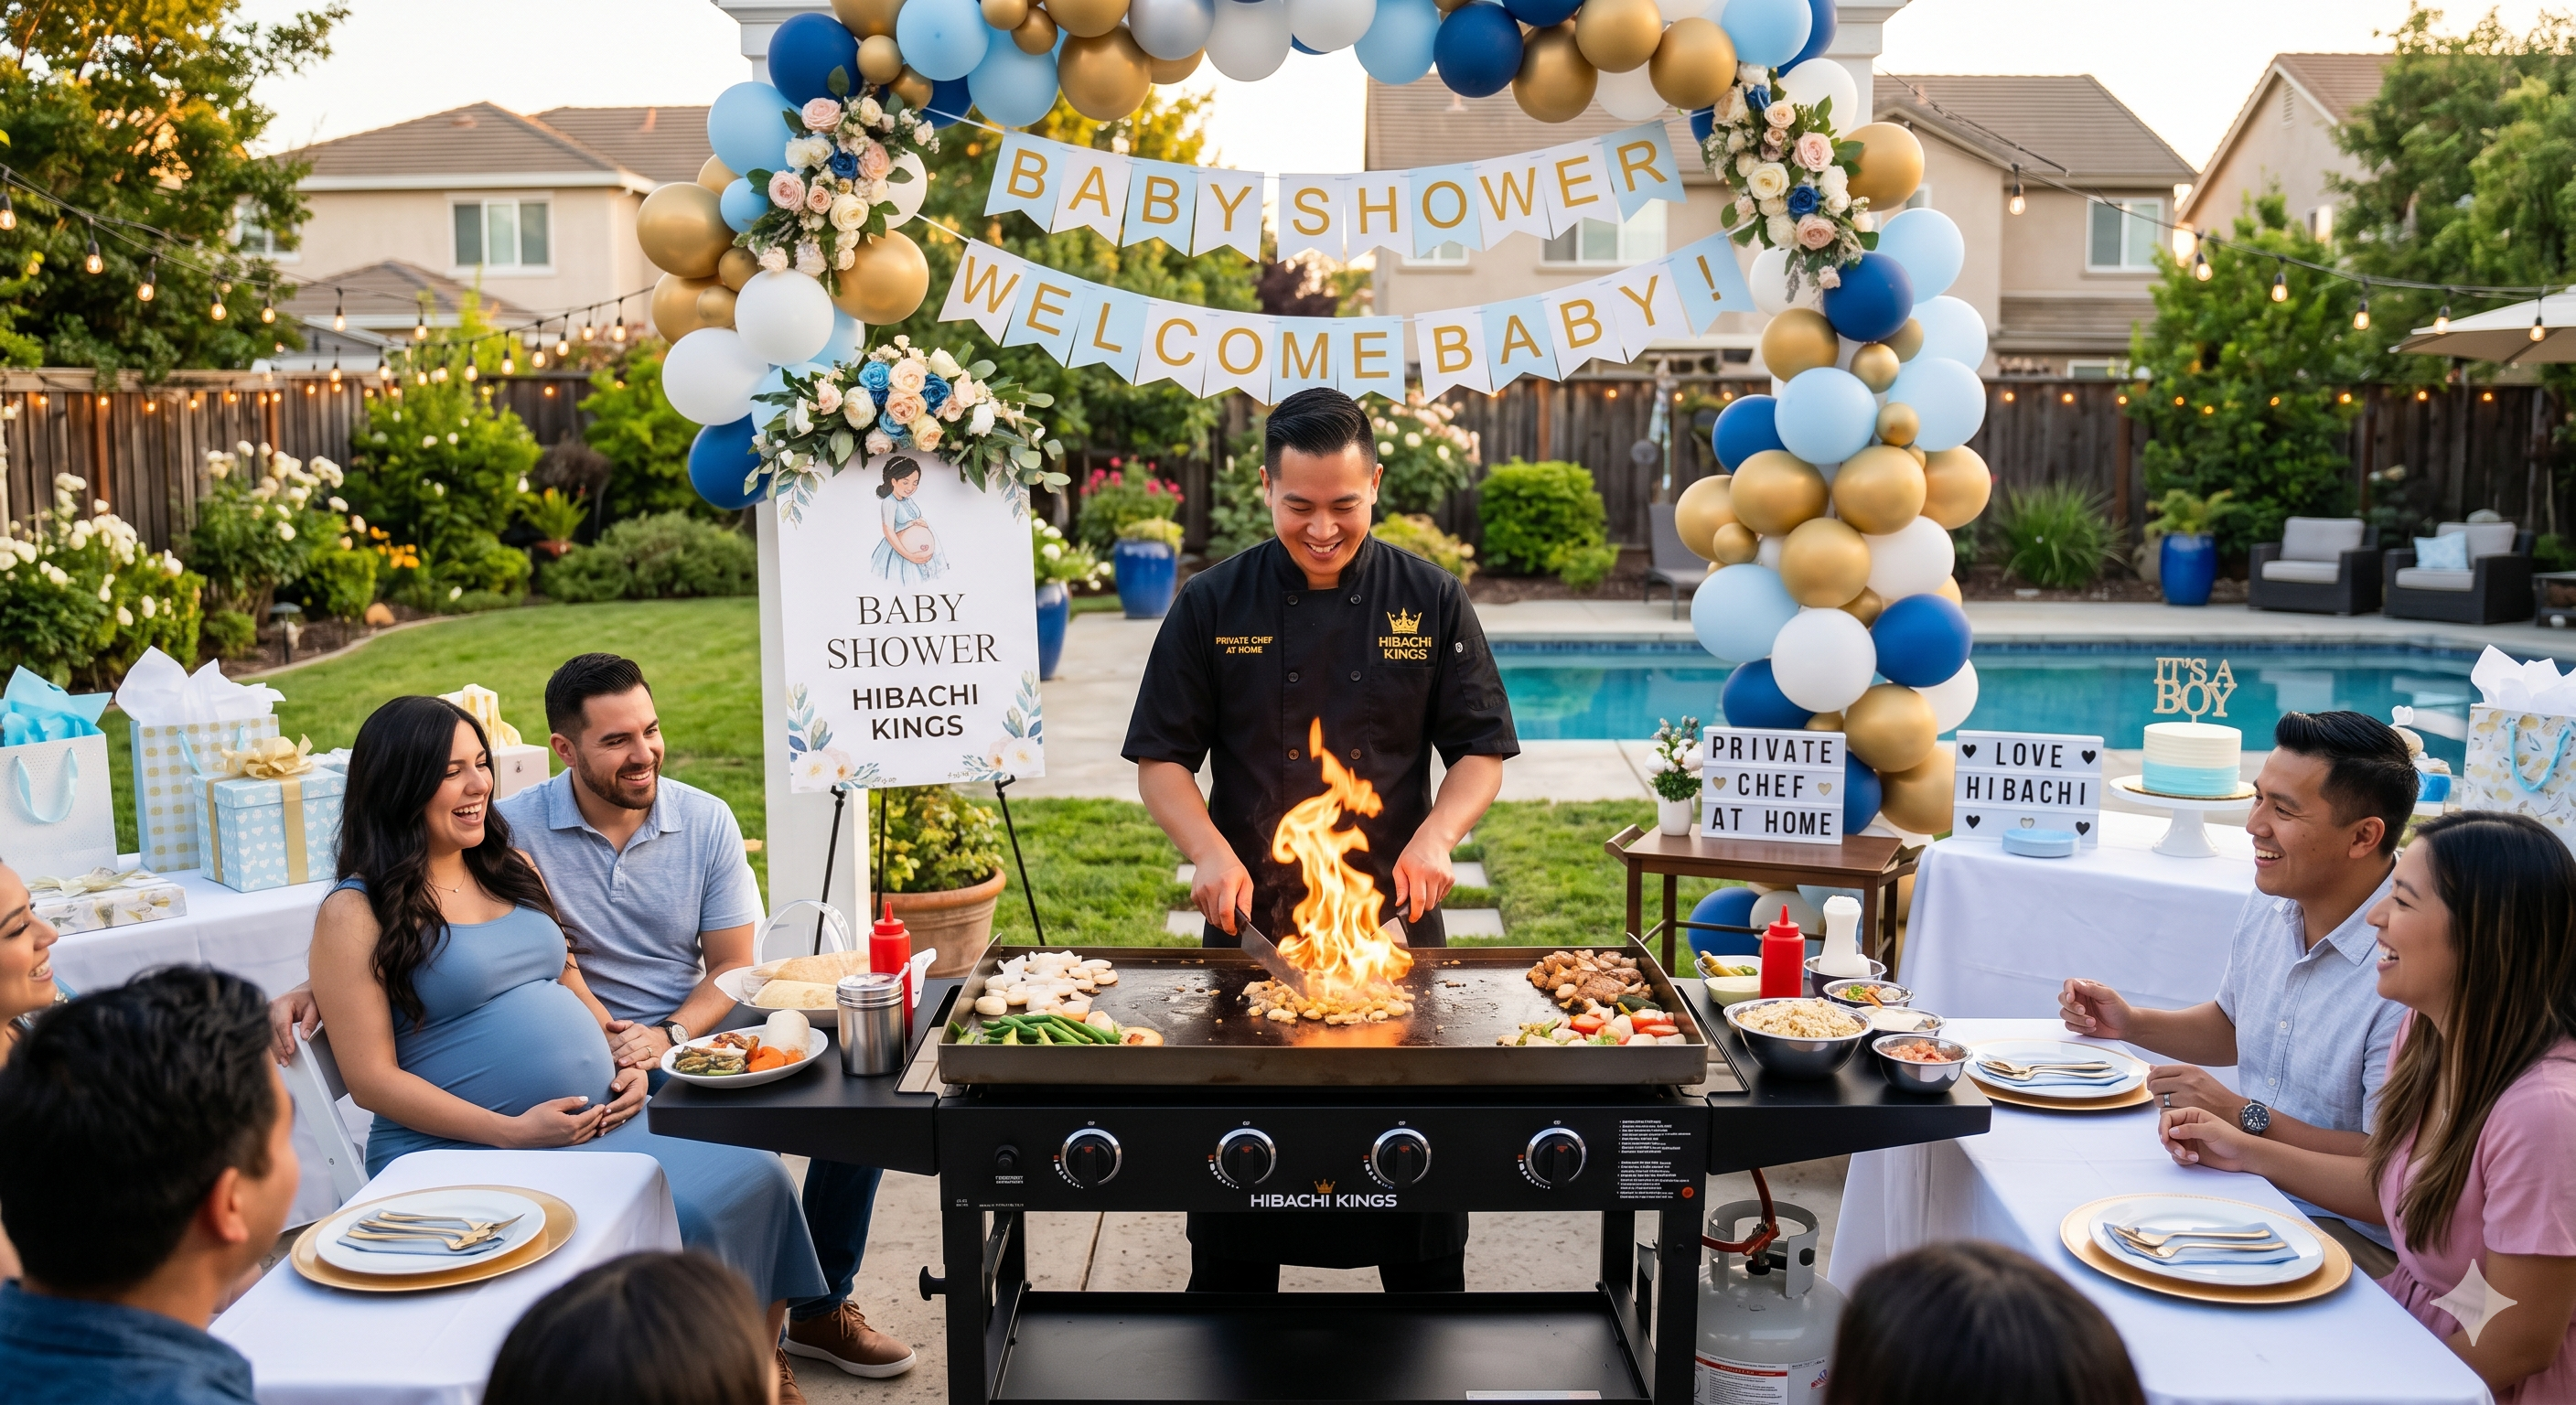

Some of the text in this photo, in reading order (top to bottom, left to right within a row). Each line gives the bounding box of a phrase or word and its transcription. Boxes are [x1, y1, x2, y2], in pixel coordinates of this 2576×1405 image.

[1006, 140, 1668, 236] BABY SHOWER
[963, 255, 1390, 380] WELCOME
[856, 594, 965, 626] BABY
[827, 633, 1002, 670] SHOWER
[1216, 636, 1273, 645] PRIVATE CHEF
[1226, 646, 1263, 654] AT HOME
[1383, 649, 1428, 660] KINGS
[2153, 657, 2238, 688] IT'S A
[853, 683, 979, 711] HIBACHI
[2152, 681, 2237, 718] BOY
[872, 714, 964, 741] KINGS
[1712, 735, 1833, 764] PRIVATE
[1996, 742, 2064, 768] LOVE
[1738, 772, 1806, 799] CHEF
[1966, 776, 2087, 806] HIBACHI
[1712, 807, 1832, 836] AT HOME
[1250, 1194, 1398, 1207] HIBACHI KINGS
